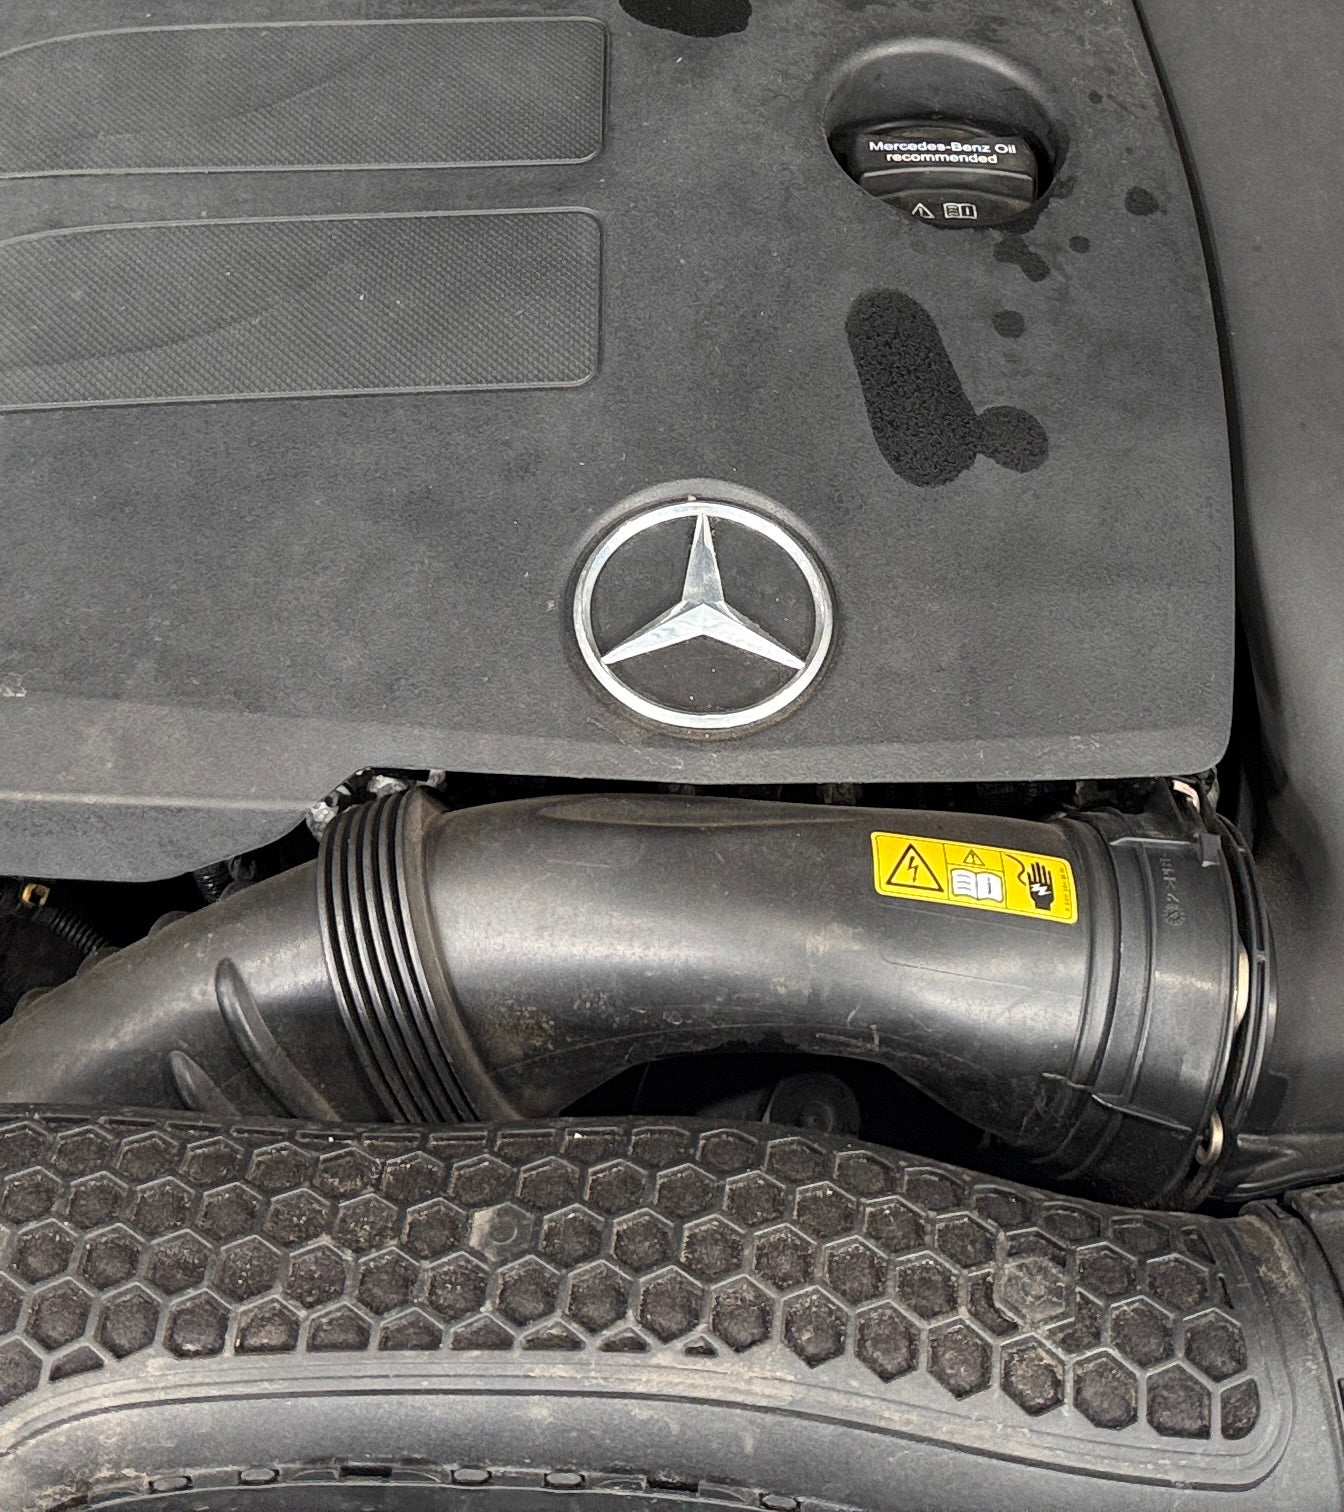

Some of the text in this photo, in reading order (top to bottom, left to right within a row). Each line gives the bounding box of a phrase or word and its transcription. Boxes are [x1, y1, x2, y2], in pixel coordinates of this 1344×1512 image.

[869, 141, 1017, 155] Mercedes-Benz Oil
[886, 152, 998, 164] recommended
